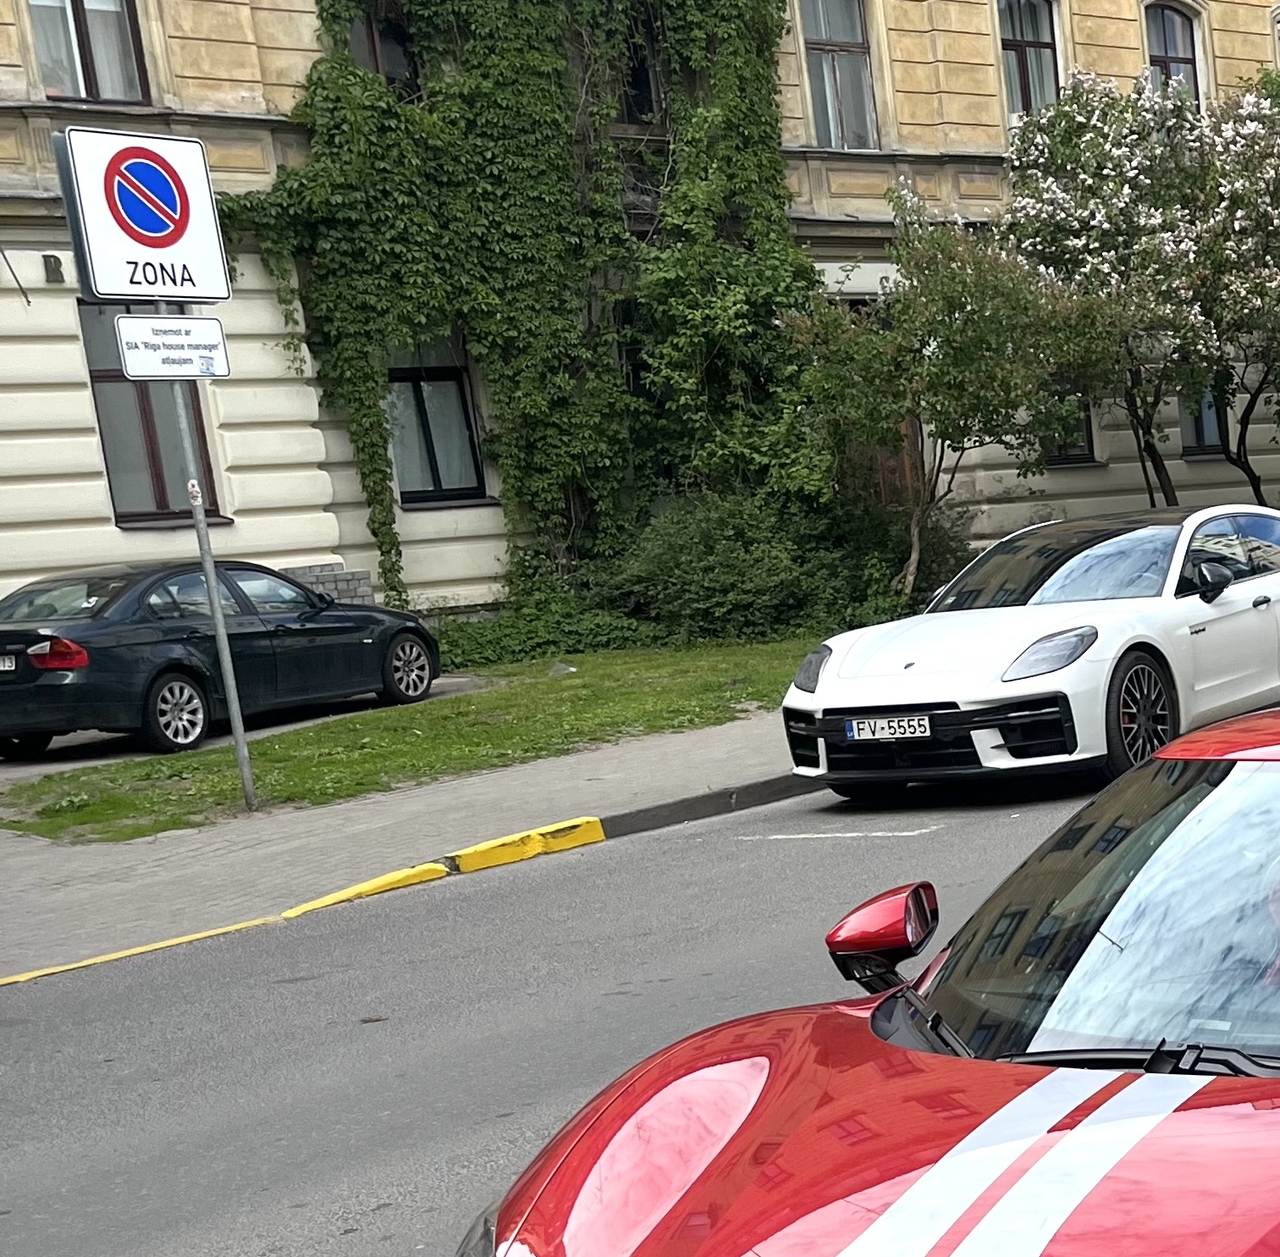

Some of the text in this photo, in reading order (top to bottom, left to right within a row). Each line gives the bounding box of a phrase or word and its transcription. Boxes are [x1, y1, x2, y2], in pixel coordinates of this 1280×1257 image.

[126, 261, 196, 287] ZONA
[125, 342, 140, 351] SIA
[162, 342, 185, 351] house
[857, 718, 927, 737] FV-5555
